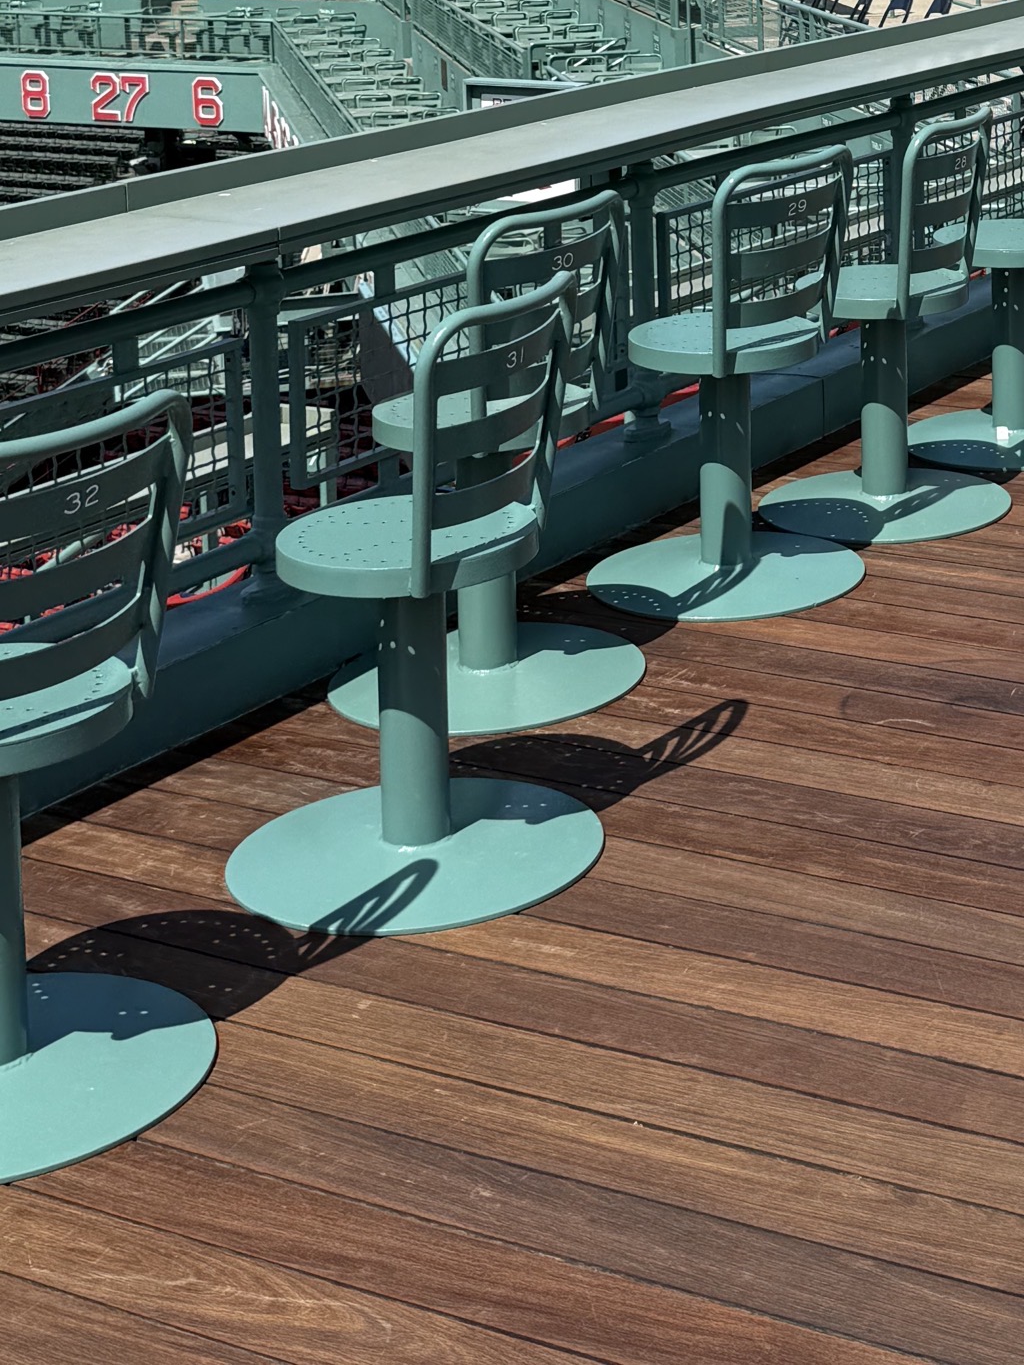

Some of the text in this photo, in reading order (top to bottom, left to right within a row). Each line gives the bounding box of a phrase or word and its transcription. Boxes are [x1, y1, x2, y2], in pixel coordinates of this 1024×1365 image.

[21, 70, 51, 119] 8
[90, 72, 149, 122] 27
[192, 76, 224, 127] 6
[954, 156, 967, 170] 28
[788, 199, 808, 217] 29
[551, 252, 575, 271] 30
[506, 348, 525, 369] 31
[64, 485, 99, 515] 32
